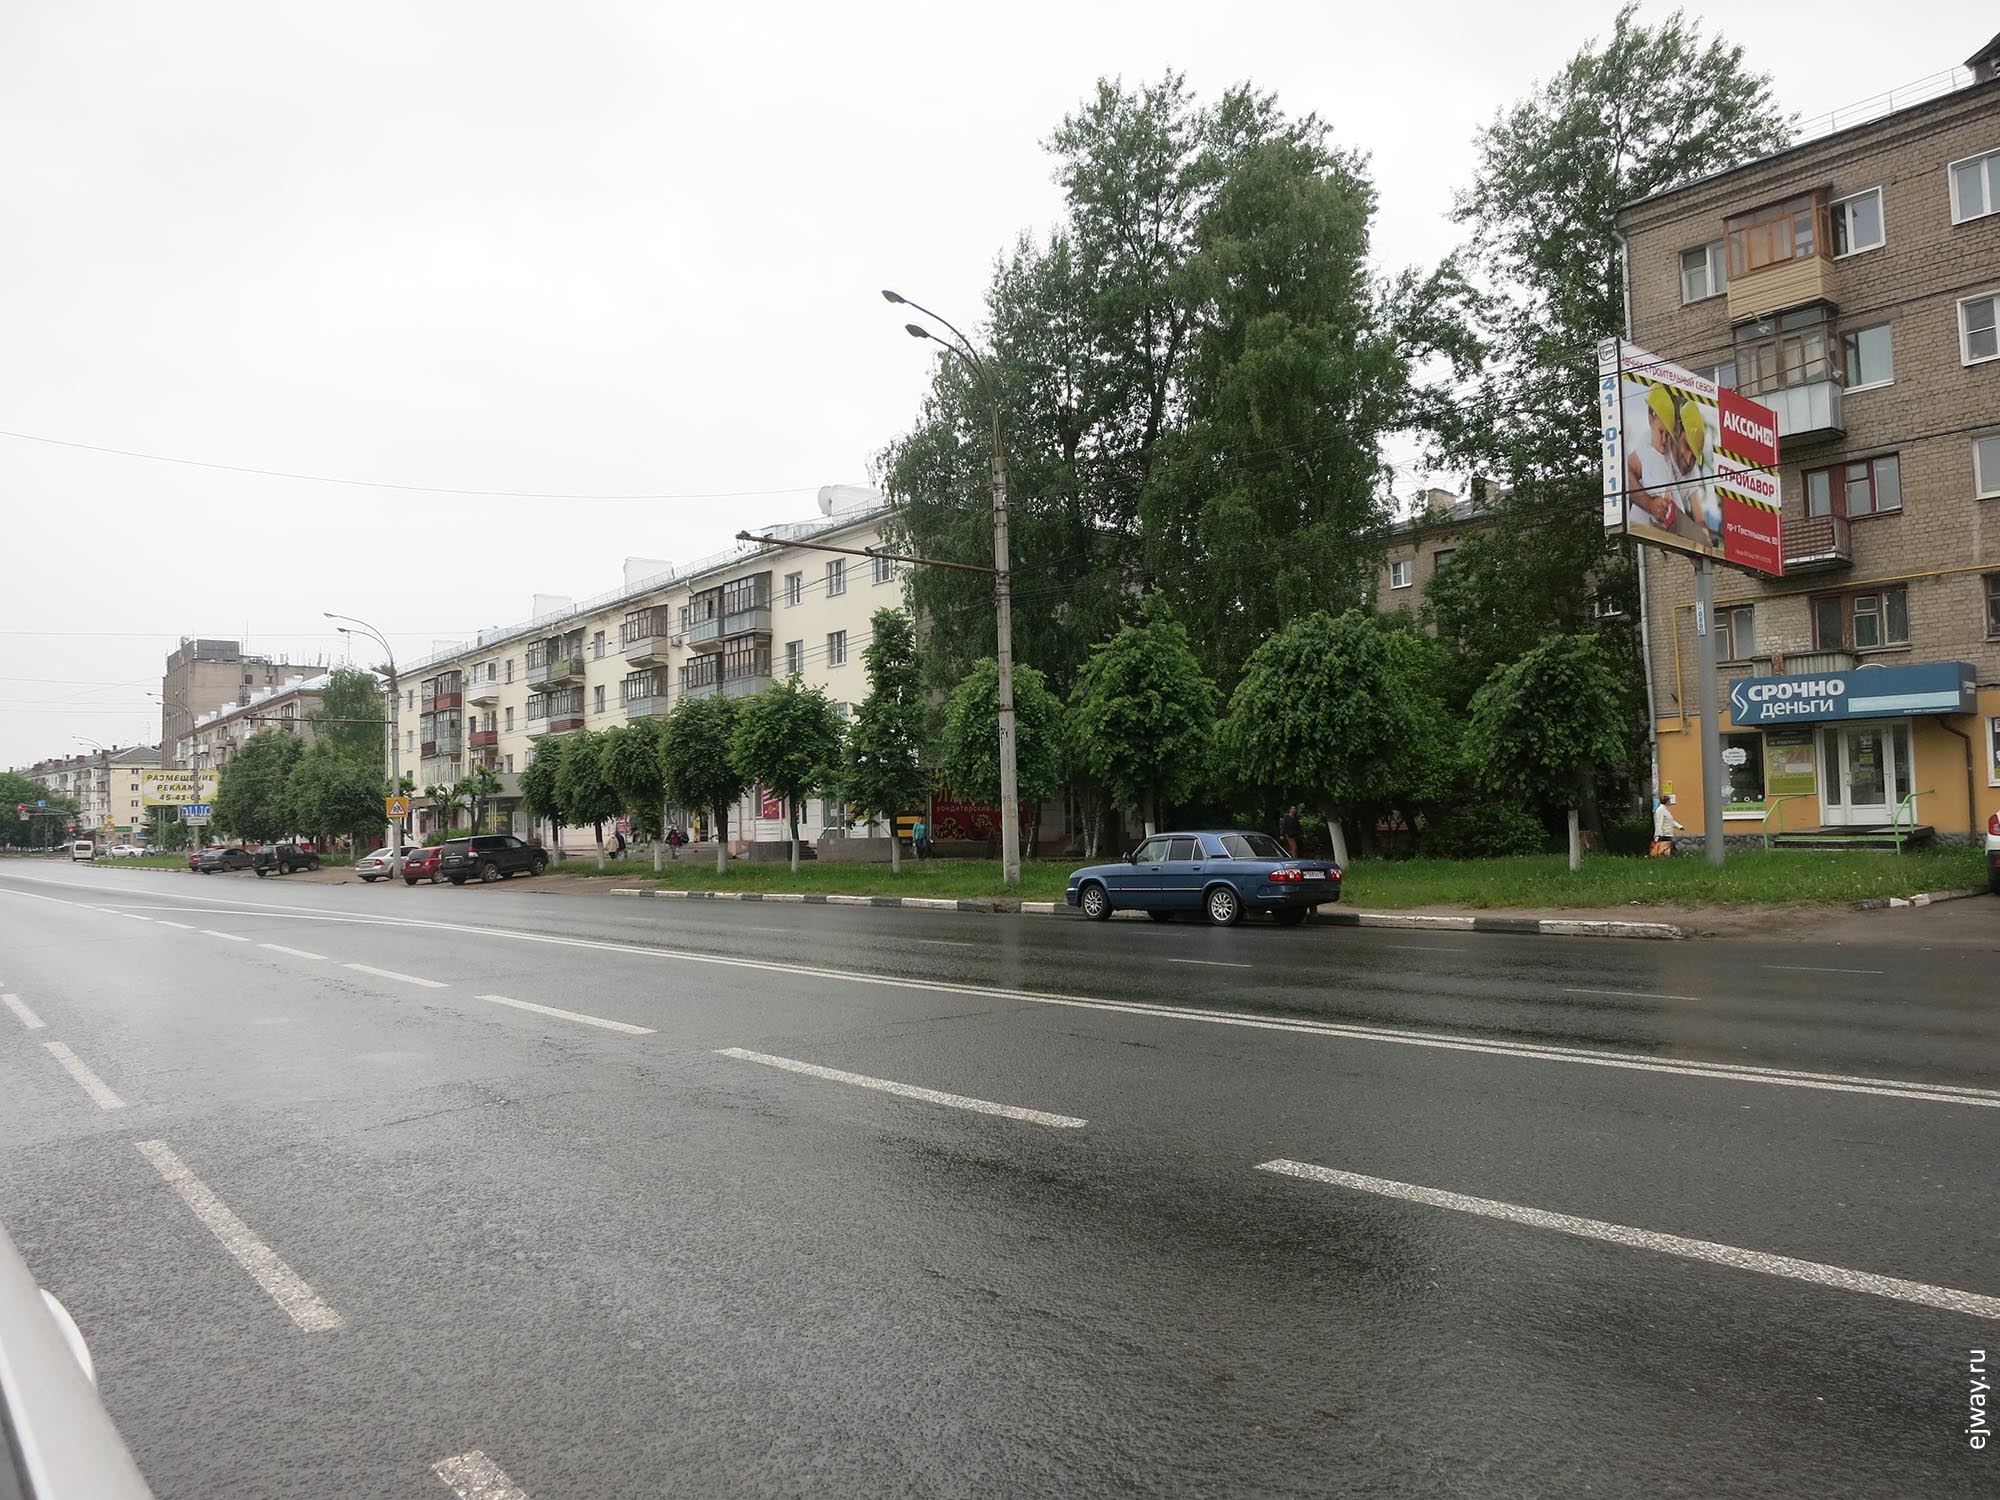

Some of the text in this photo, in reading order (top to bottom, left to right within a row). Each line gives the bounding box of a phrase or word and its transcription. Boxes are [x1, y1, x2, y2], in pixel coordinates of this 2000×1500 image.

[1723, 409, 1763, 443] АКСОН
[1717, 463, 1775, 498] СТРОЙДВОР
[1747, 679, 1845, 701] СРОЧНО
[1760, 699, 1834, 719] деньги
